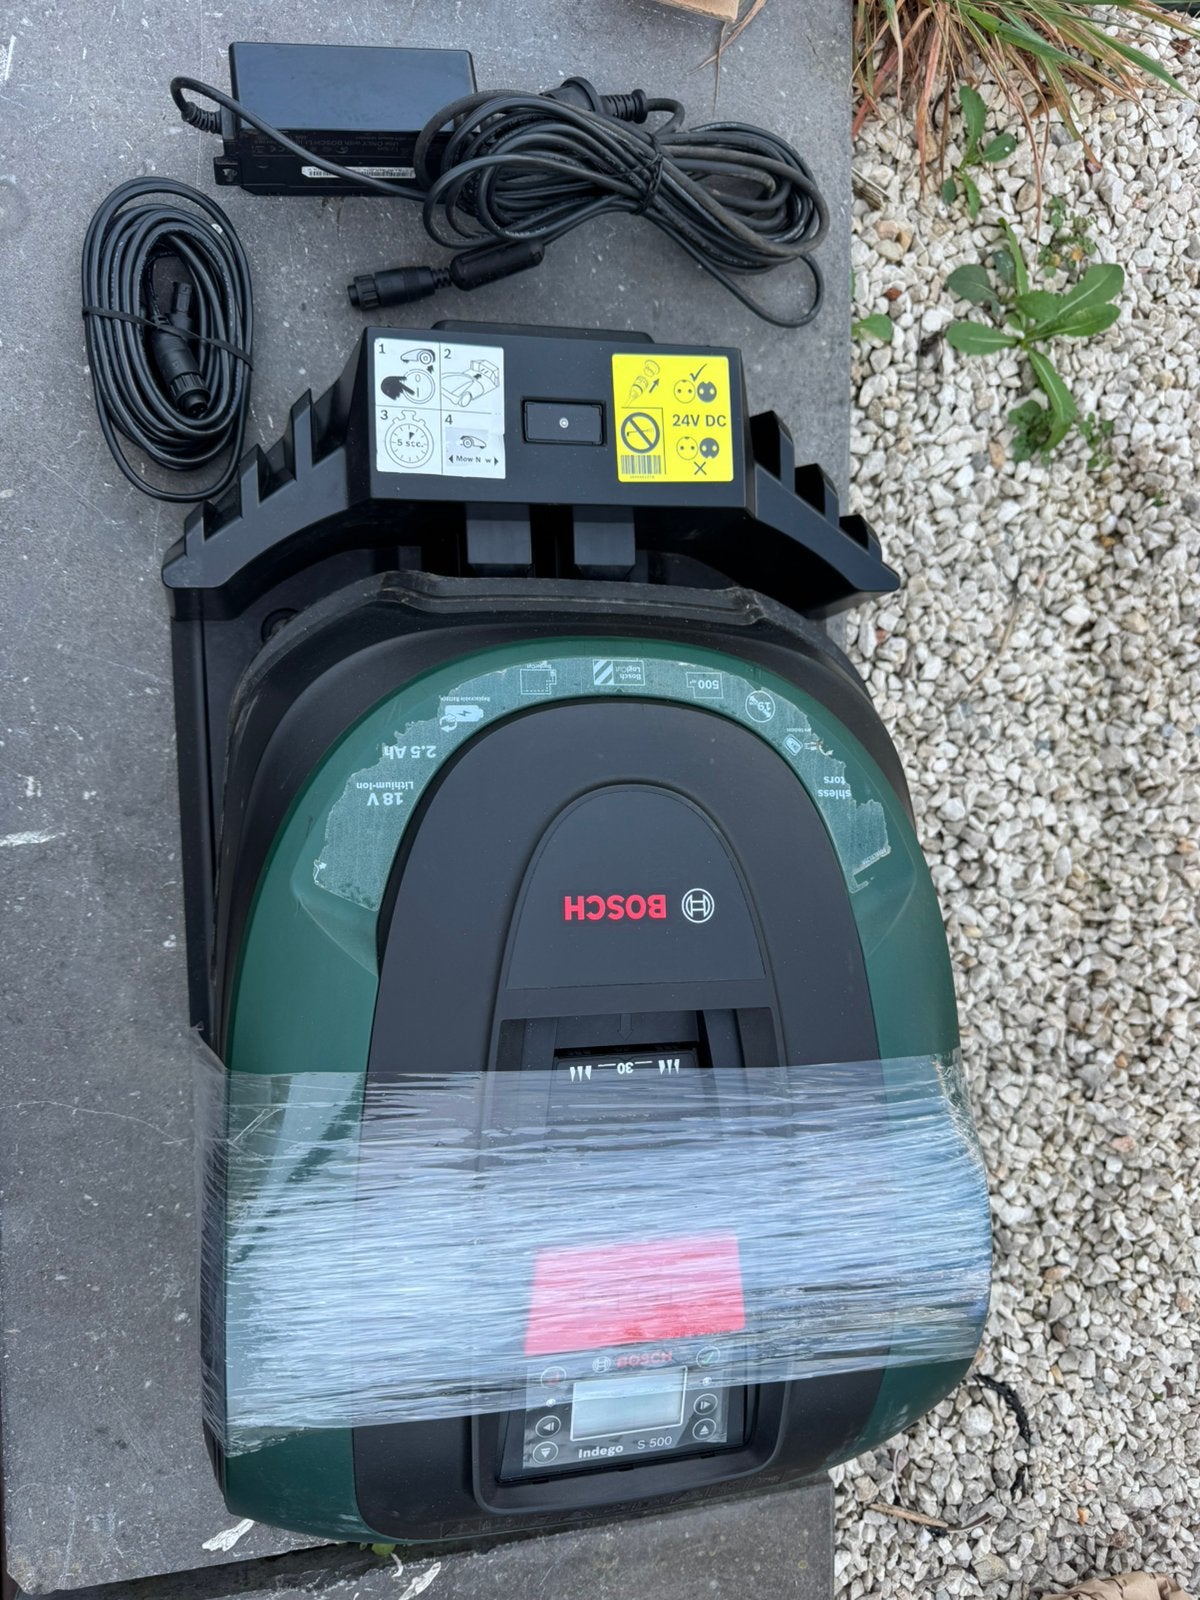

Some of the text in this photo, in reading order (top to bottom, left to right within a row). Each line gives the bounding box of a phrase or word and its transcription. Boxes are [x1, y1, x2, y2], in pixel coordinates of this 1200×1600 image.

[378, 343, 386, 354] 1
[444, 348, 452, 359] 2
[380, 410, 388, 421] 3
[445, 414, 453, 425] 4
[672, 414, 727, 428] 24V DC
[397, 438, 403, 447] 5
[456, 455, 473, 463] Mow
[619, 673, 642, 681] Bosch
[697, 679, 719, 690] 500
[757, 701, 771, 711] 19
[383, 744, 437, 759] 2.5 Ah
[356, 780, 414, 790] Lithium-Ion
[823, 776, 846, 785] tors
[366, 792, 404, 806] 18 V
[564, 894, 667, 921] BOSCH
[617, 1062, 634, 1075] 30
[616, 1350, 673, 1369] BOSCH
[578, 1436, 673, 1459] Indego S 500
